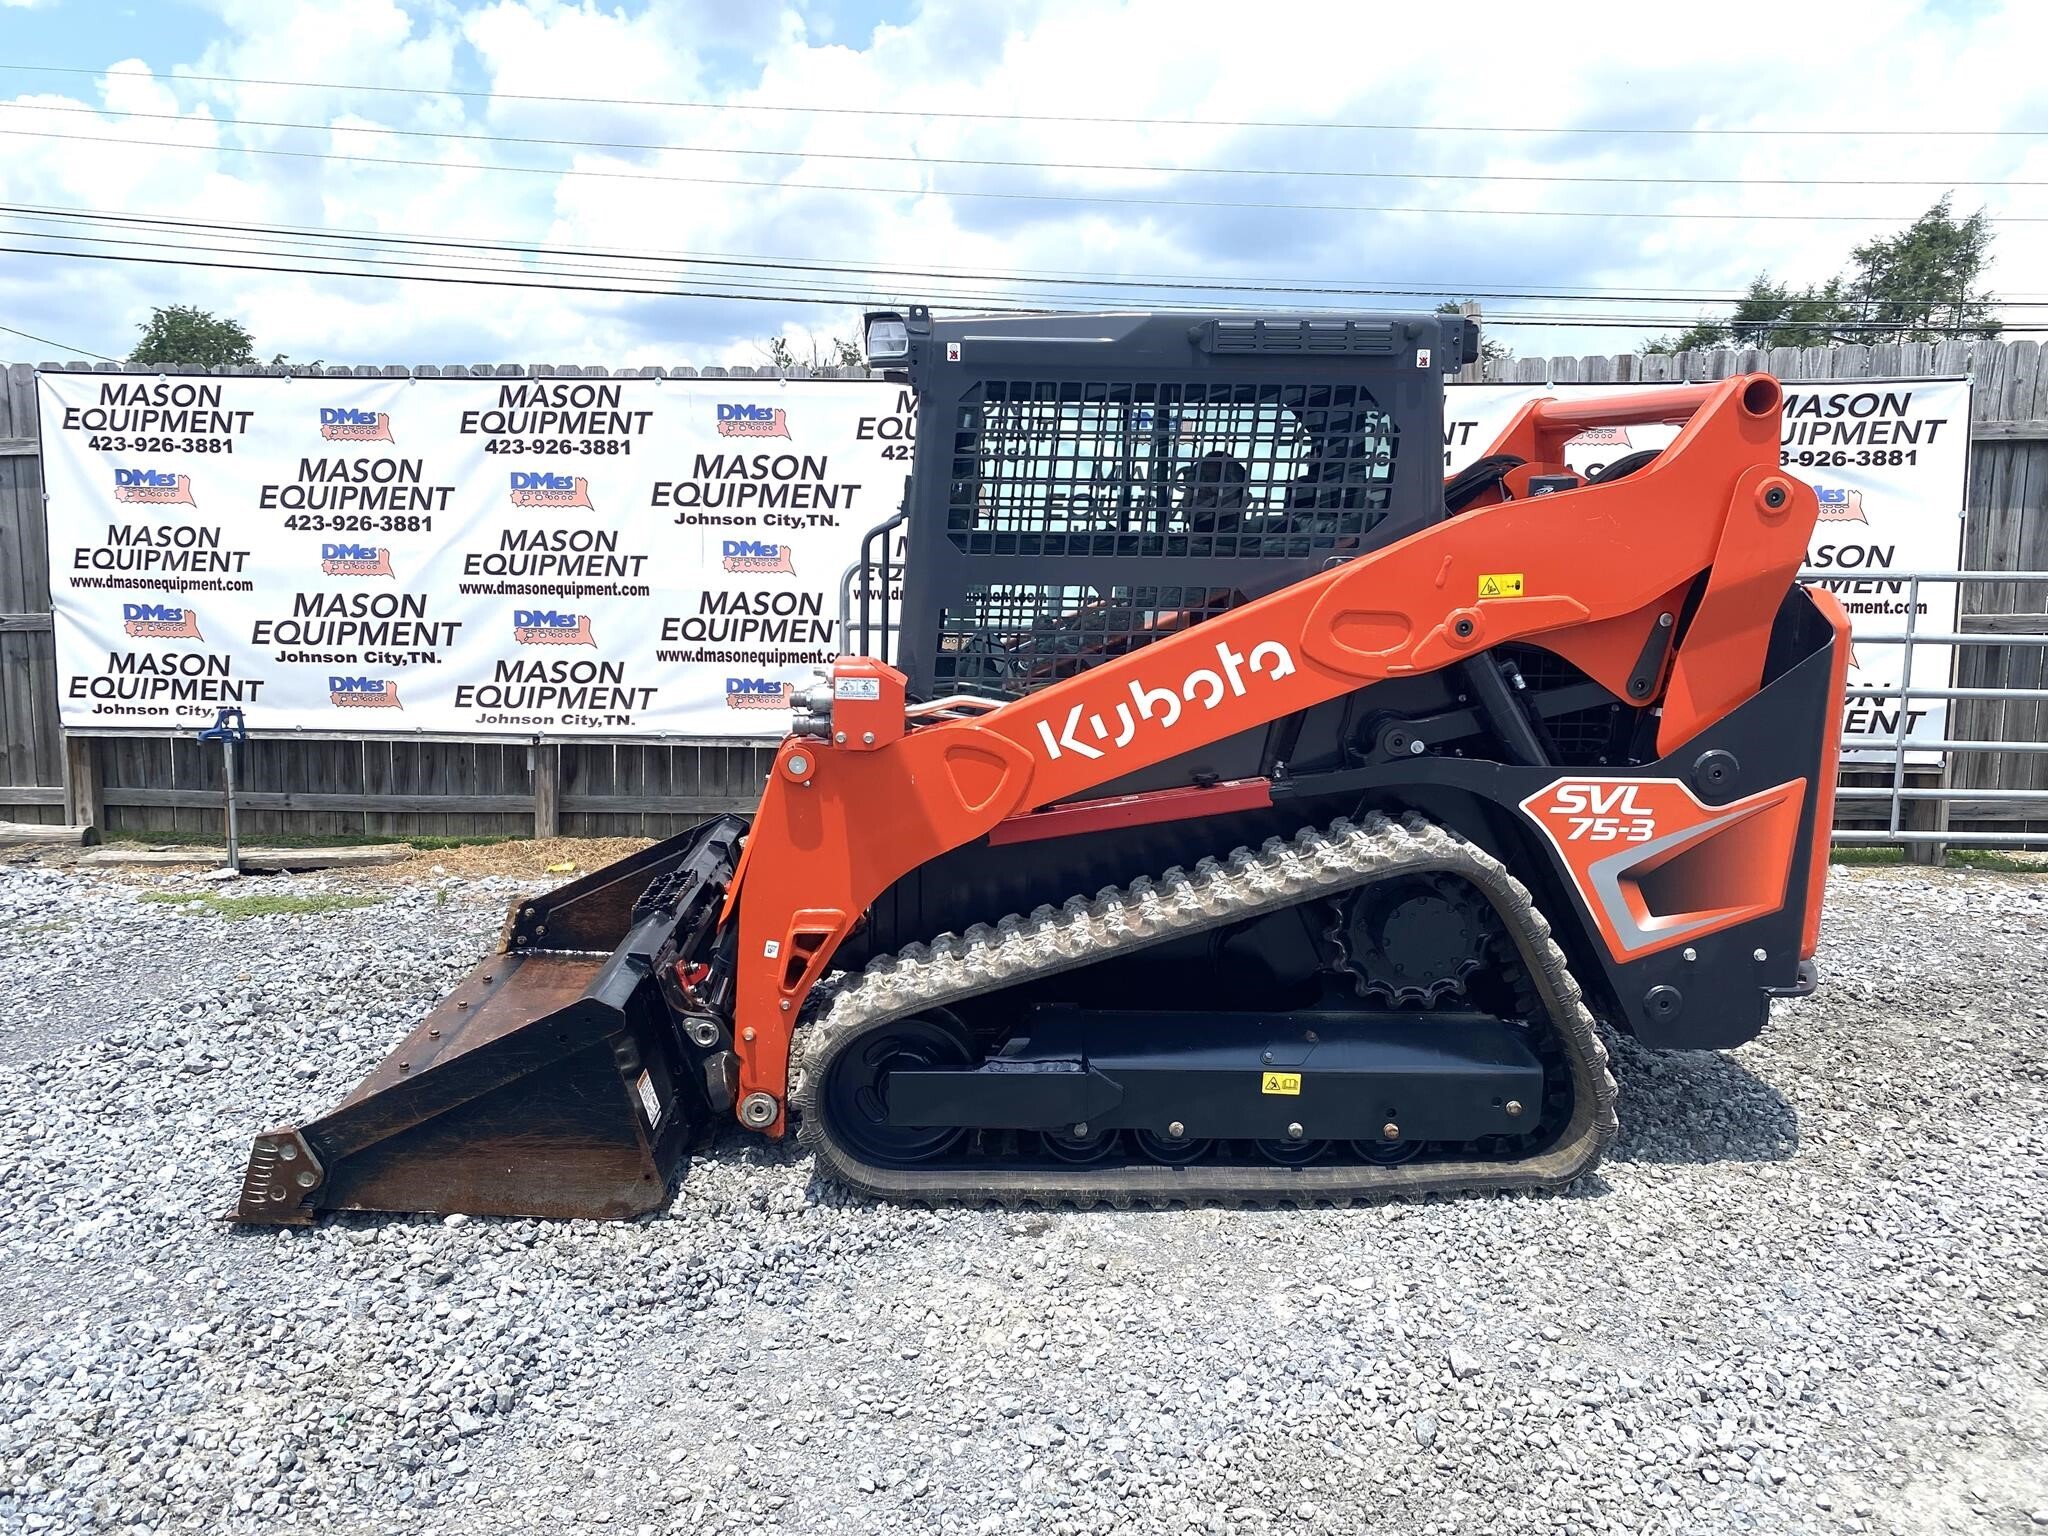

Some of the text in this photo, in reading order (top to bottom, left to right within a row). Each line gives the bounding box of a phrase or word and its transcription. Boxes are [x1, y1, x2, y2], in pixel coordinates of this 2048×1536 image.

[100, 384, 221, 407] MASON
[499, 385, 621, 408] MASON
[63, 408, 253, 433] EQUIPMENT
[460, 411, 653, 434] EQUIPMENT
[1781, 419, 1947, 445] UIPMENT
[89, 436, 232, 453] 423-926-3881
[485, 439, 630, 454] 423-926-3881
[693, 455, 827, 480] MASON
[1780, 450, 1917, 466] 3-926-3881
[299, 459, 422, 483] MASON
[260, 485, 455, 510] EQUIPMENT
[651, 482, 861, 508] EQUIPMENT
[285, 515, 431, 531] 423-926-3881
[675, 513, 839, 529] Johnson City,TN.
[108, 525, 220, 547] MASON
[500, 530, 618, 551] MASON
[74, 548, 250, 572] EQUIPMENT
[464, 554, 648, 576] EQUIPMENT
[70, 575, 253, 593] www.dmasonequipment.com
[459, 581, 649, 598] www.dmasonequipment.com
[294, 593, 426, 618] MASON
[700, 591, 823, 616] MASON
[252, 621, 462, 646] EQUIPMENT
[660, 617, 840, 643] EQUIPMEN
[108, 652, 230, 676] MASON
[275, 651, 441, 666] Johnson City,TN.
[655, 648, 844, 667] www.dmasonequipment.c
[495, 660, 624, 683] MASON
[69, 677, 264, 701] EQUIPMENT
[455, 686, 657, 709] EQUIPMENT
[1036, 640, 1296, 760] Kubota
[92, 704, 246, 718] Johnson City,.
[476, 714, 635, 727] Johnson City,TN.
[1549, 785, 1654, 815] SVL
[1567, 818, 1655, 842] 75-3
